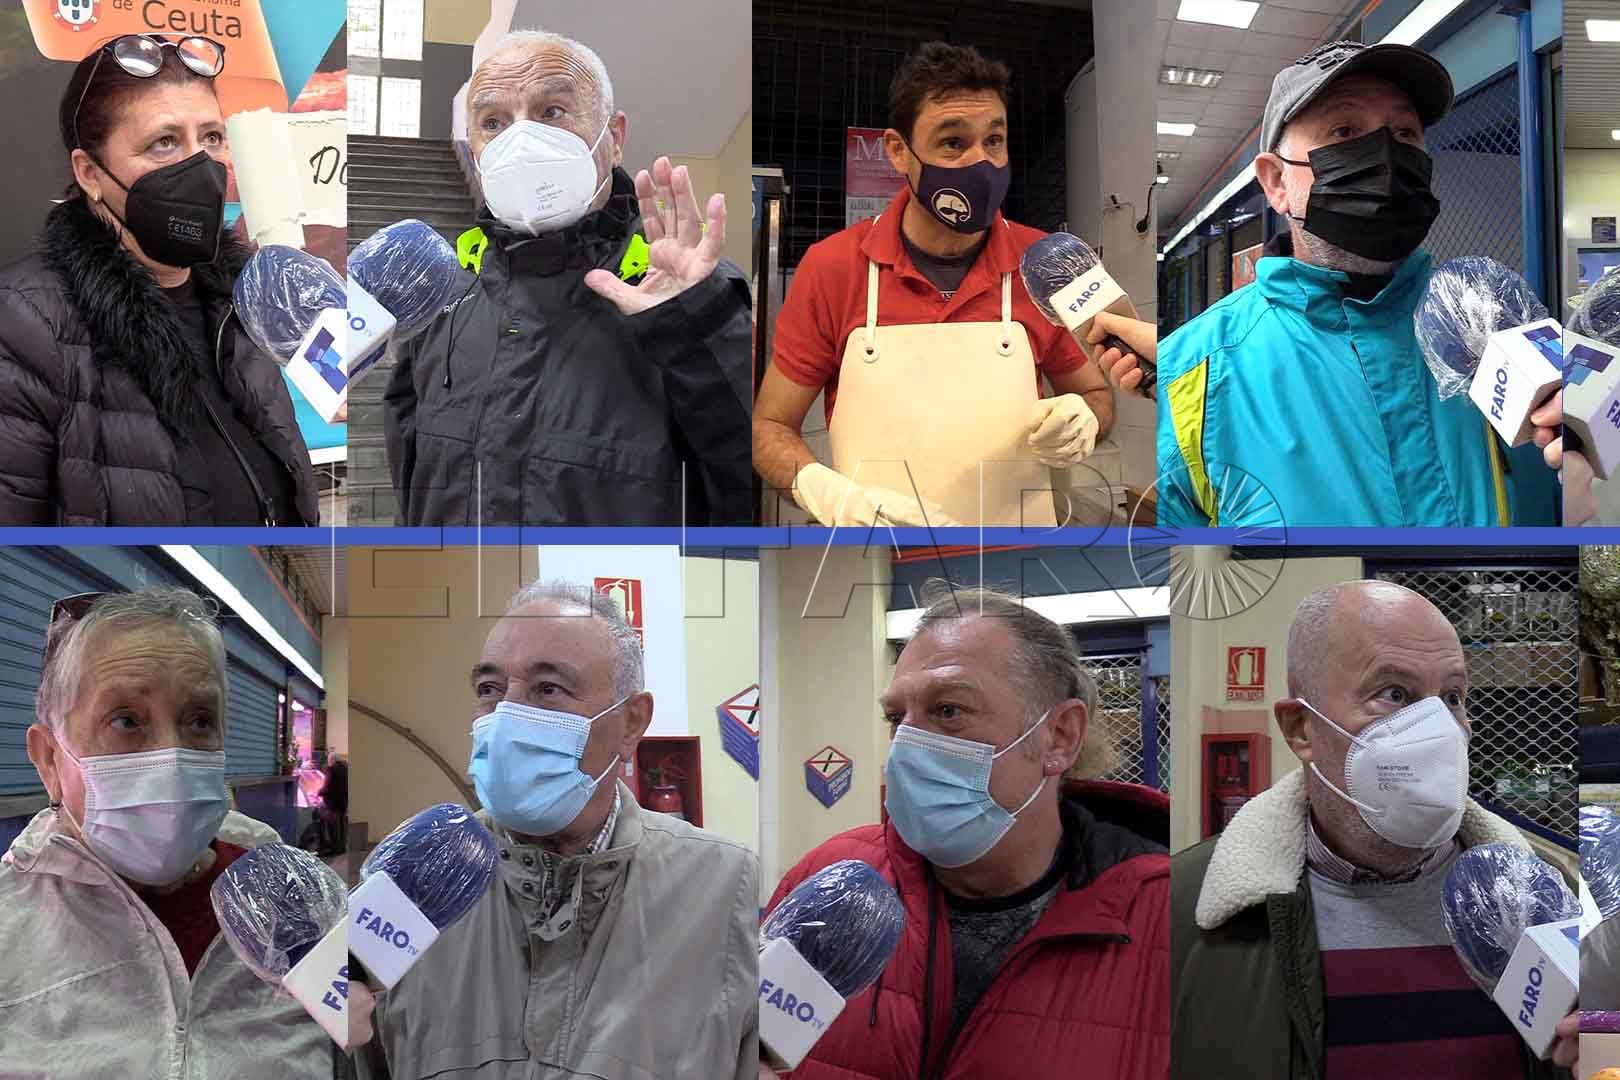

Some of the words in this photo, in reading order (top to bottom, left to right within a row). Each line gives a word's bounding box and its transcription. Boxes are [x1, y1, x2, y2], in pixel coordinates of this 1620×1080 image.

[113, 0, 133, 10] de
[142, 0, 242, 38] Ceuta
[1069, 281, 1101, 313] FARO
[1491, 367, 1508, 420] FARO
[356, 908, 410, 949] FARO
[759, 978, 814, 1023] FARO
[1518, 967, 1543, 1029] FARO
